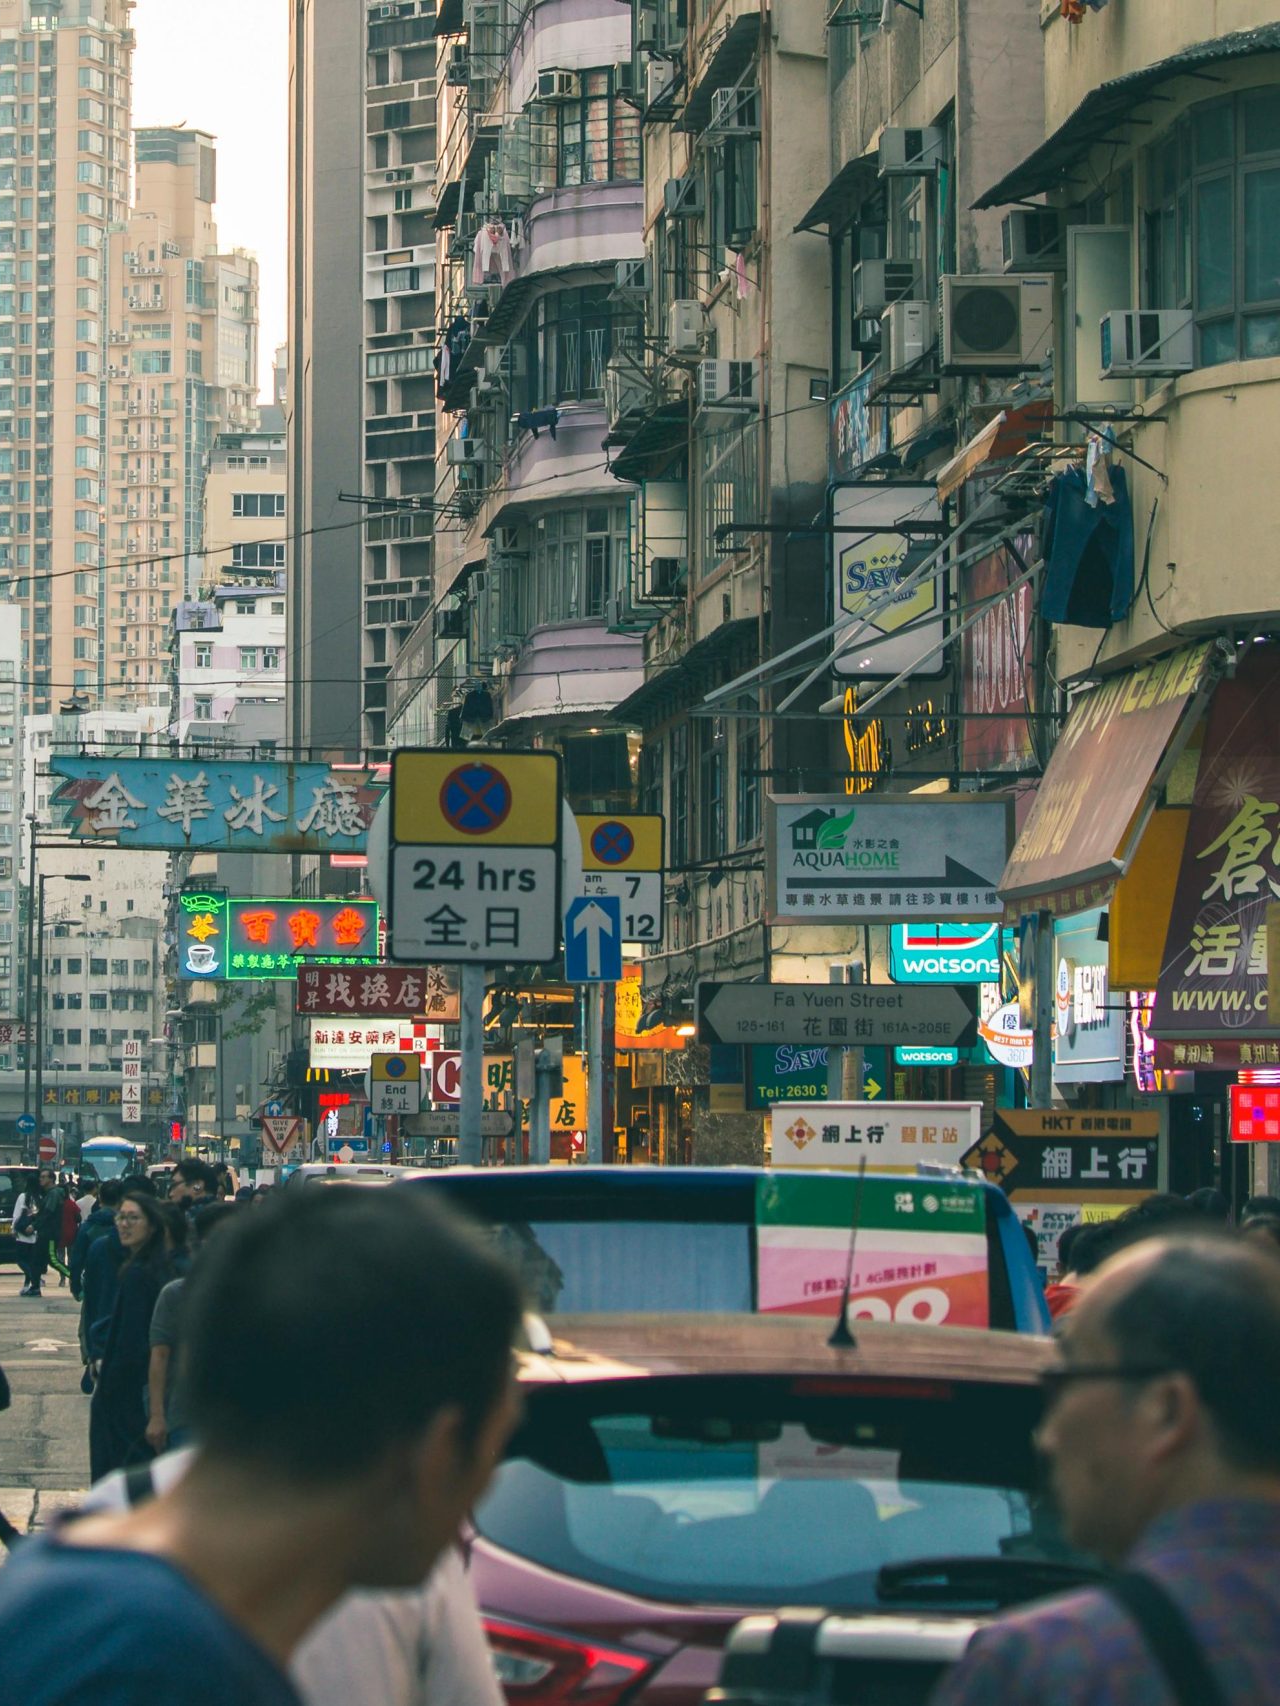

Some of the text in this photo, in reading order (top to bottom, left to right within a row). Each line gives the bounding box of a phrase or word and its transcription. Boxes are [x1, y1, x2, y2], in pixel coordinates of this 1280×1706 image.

[83, 771, 371, 837] 金華冰廳
[793, 851, 900, 871] AQUAHOME
[413, 859, 536, 892] 24 hrs
[585, 874, 602, 883] am
[625, 878, 641, 898] 7
[240, 908, 365, 947] 百寶堂
[424, 904, 520, 947] 全日
[626, 915, 654, 936] 12
[902, 957, 1001, 974] watsons
[325, 972, 421, 1008] 找換店
[773, 992, 903, 1008] Fa Yuen Street
[737, 1021, 785, 1032] 125-161
[803, 1017, 873, 1037] 花園街
[882, 1023, 951, 1034] 161A-205E
[314, 1030, 396, 1045] 新達安藥房
[902, 1051, 953, 1062] watsons
[1174, 1043, 1214, 1064] 真知味
[1240, 1043, 1280, 1064] 真知味
[125, 1041, 138, 1120] 朗曜木業
[384, 1084, 406, 1094] End
[758, 1087, 784, 1097] Tel:
[786, 1085, 817, 1097] 2630
[380, 1098, 410, 1111] 終止
[556, 1100, 576, 1126] 店
[1042, 1117, 1074, 1130] HKT
[1081, 1117, 1132, 1131] 香港電訊
[822, 1124, 959, 1145] 網上行 登記站
[1042, 1147, 1148, 1179] 網上行
[1042, 1212, 1076, 1221] PCCW
